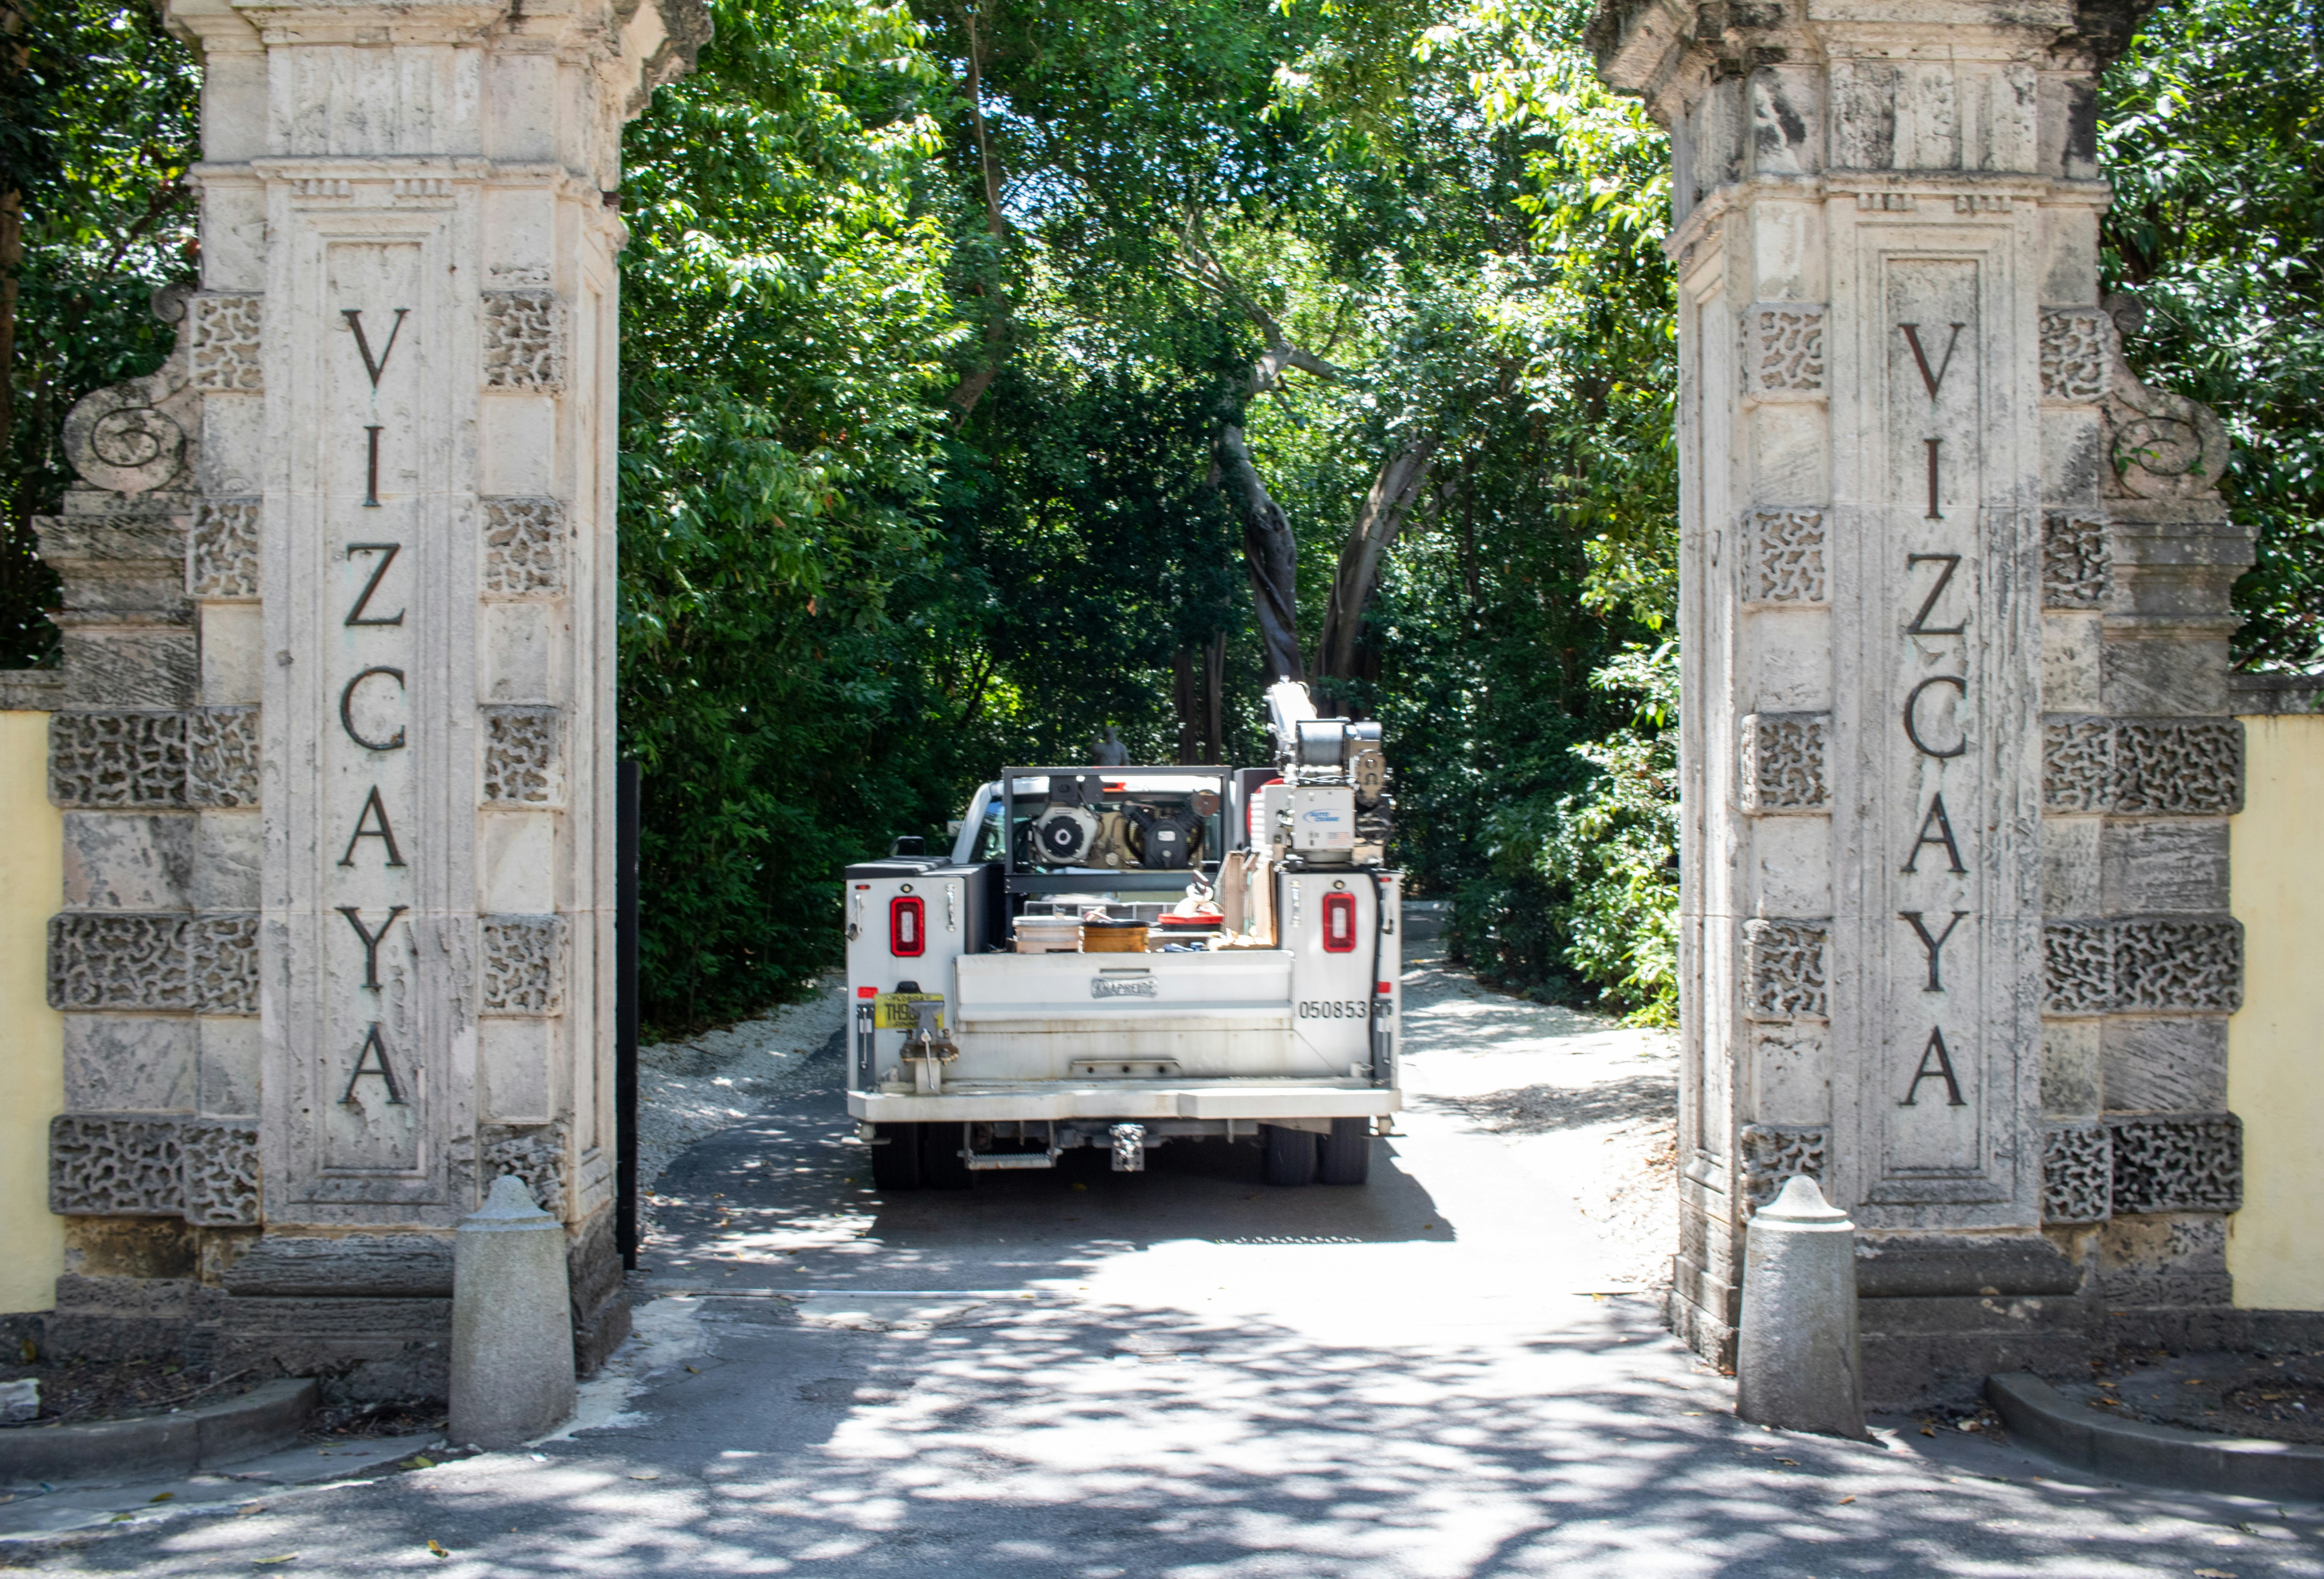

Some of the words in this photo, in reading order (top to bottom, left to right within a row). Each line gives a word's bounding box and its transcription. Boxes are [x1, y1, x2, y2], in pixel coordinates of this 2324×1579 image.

[336, 308, 410, 1105] VIZCAYA
[1300, 1001, 1366, 1018] 050853
[1897, 323, 1970, 1106] VIZCAYA
